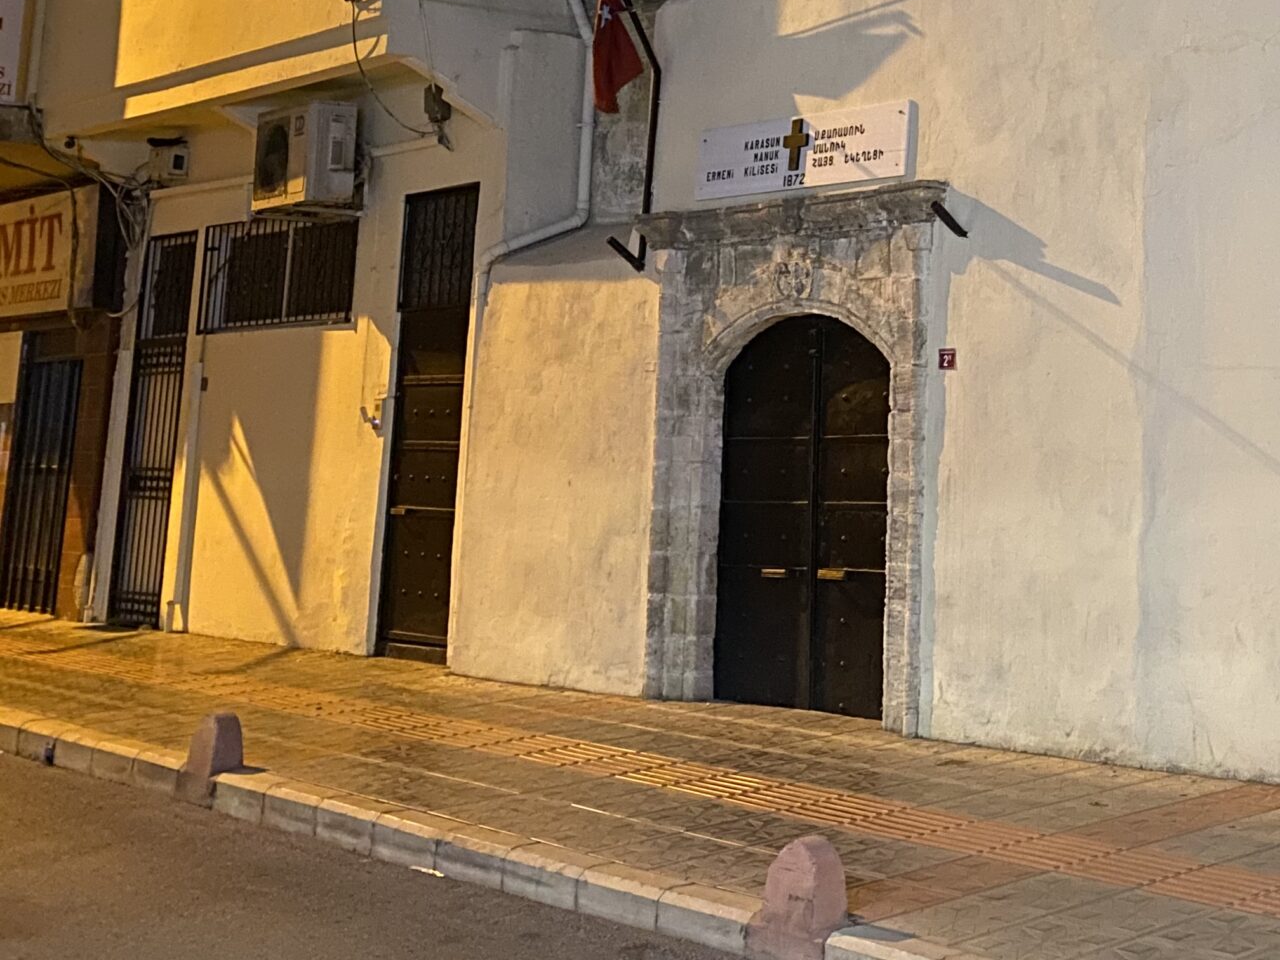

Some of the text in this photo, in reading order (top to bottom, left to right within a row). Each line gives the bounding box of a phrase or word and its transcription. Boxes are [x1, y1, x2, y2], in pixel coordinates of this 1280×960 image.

[744, 136, 781, 151] KARASUN
[753, 150, 780, 162] MANUK
[783, 173, 806, 187] 1872
